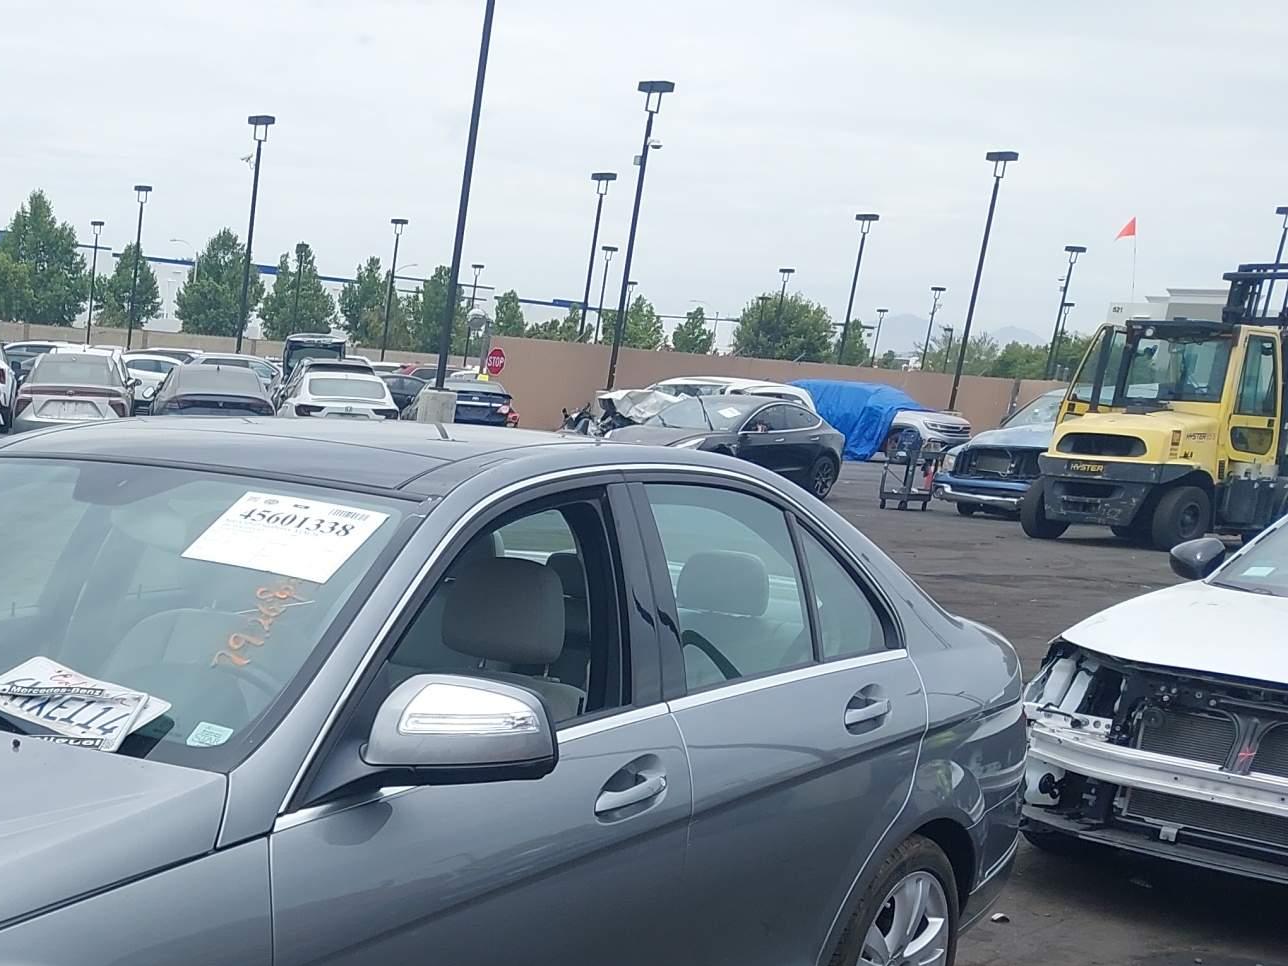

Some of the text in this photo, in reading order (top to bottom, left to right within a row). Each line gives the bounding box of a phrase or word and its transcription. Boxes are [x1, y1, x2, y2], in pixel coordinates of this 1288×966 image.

[487, 356, 504, 367] STOP
[1070, 463, 1104, 472] HYSTER
[239, 507, 355, 537] 45601338
[10, 685, 103, 697] Mercedes-Benz
